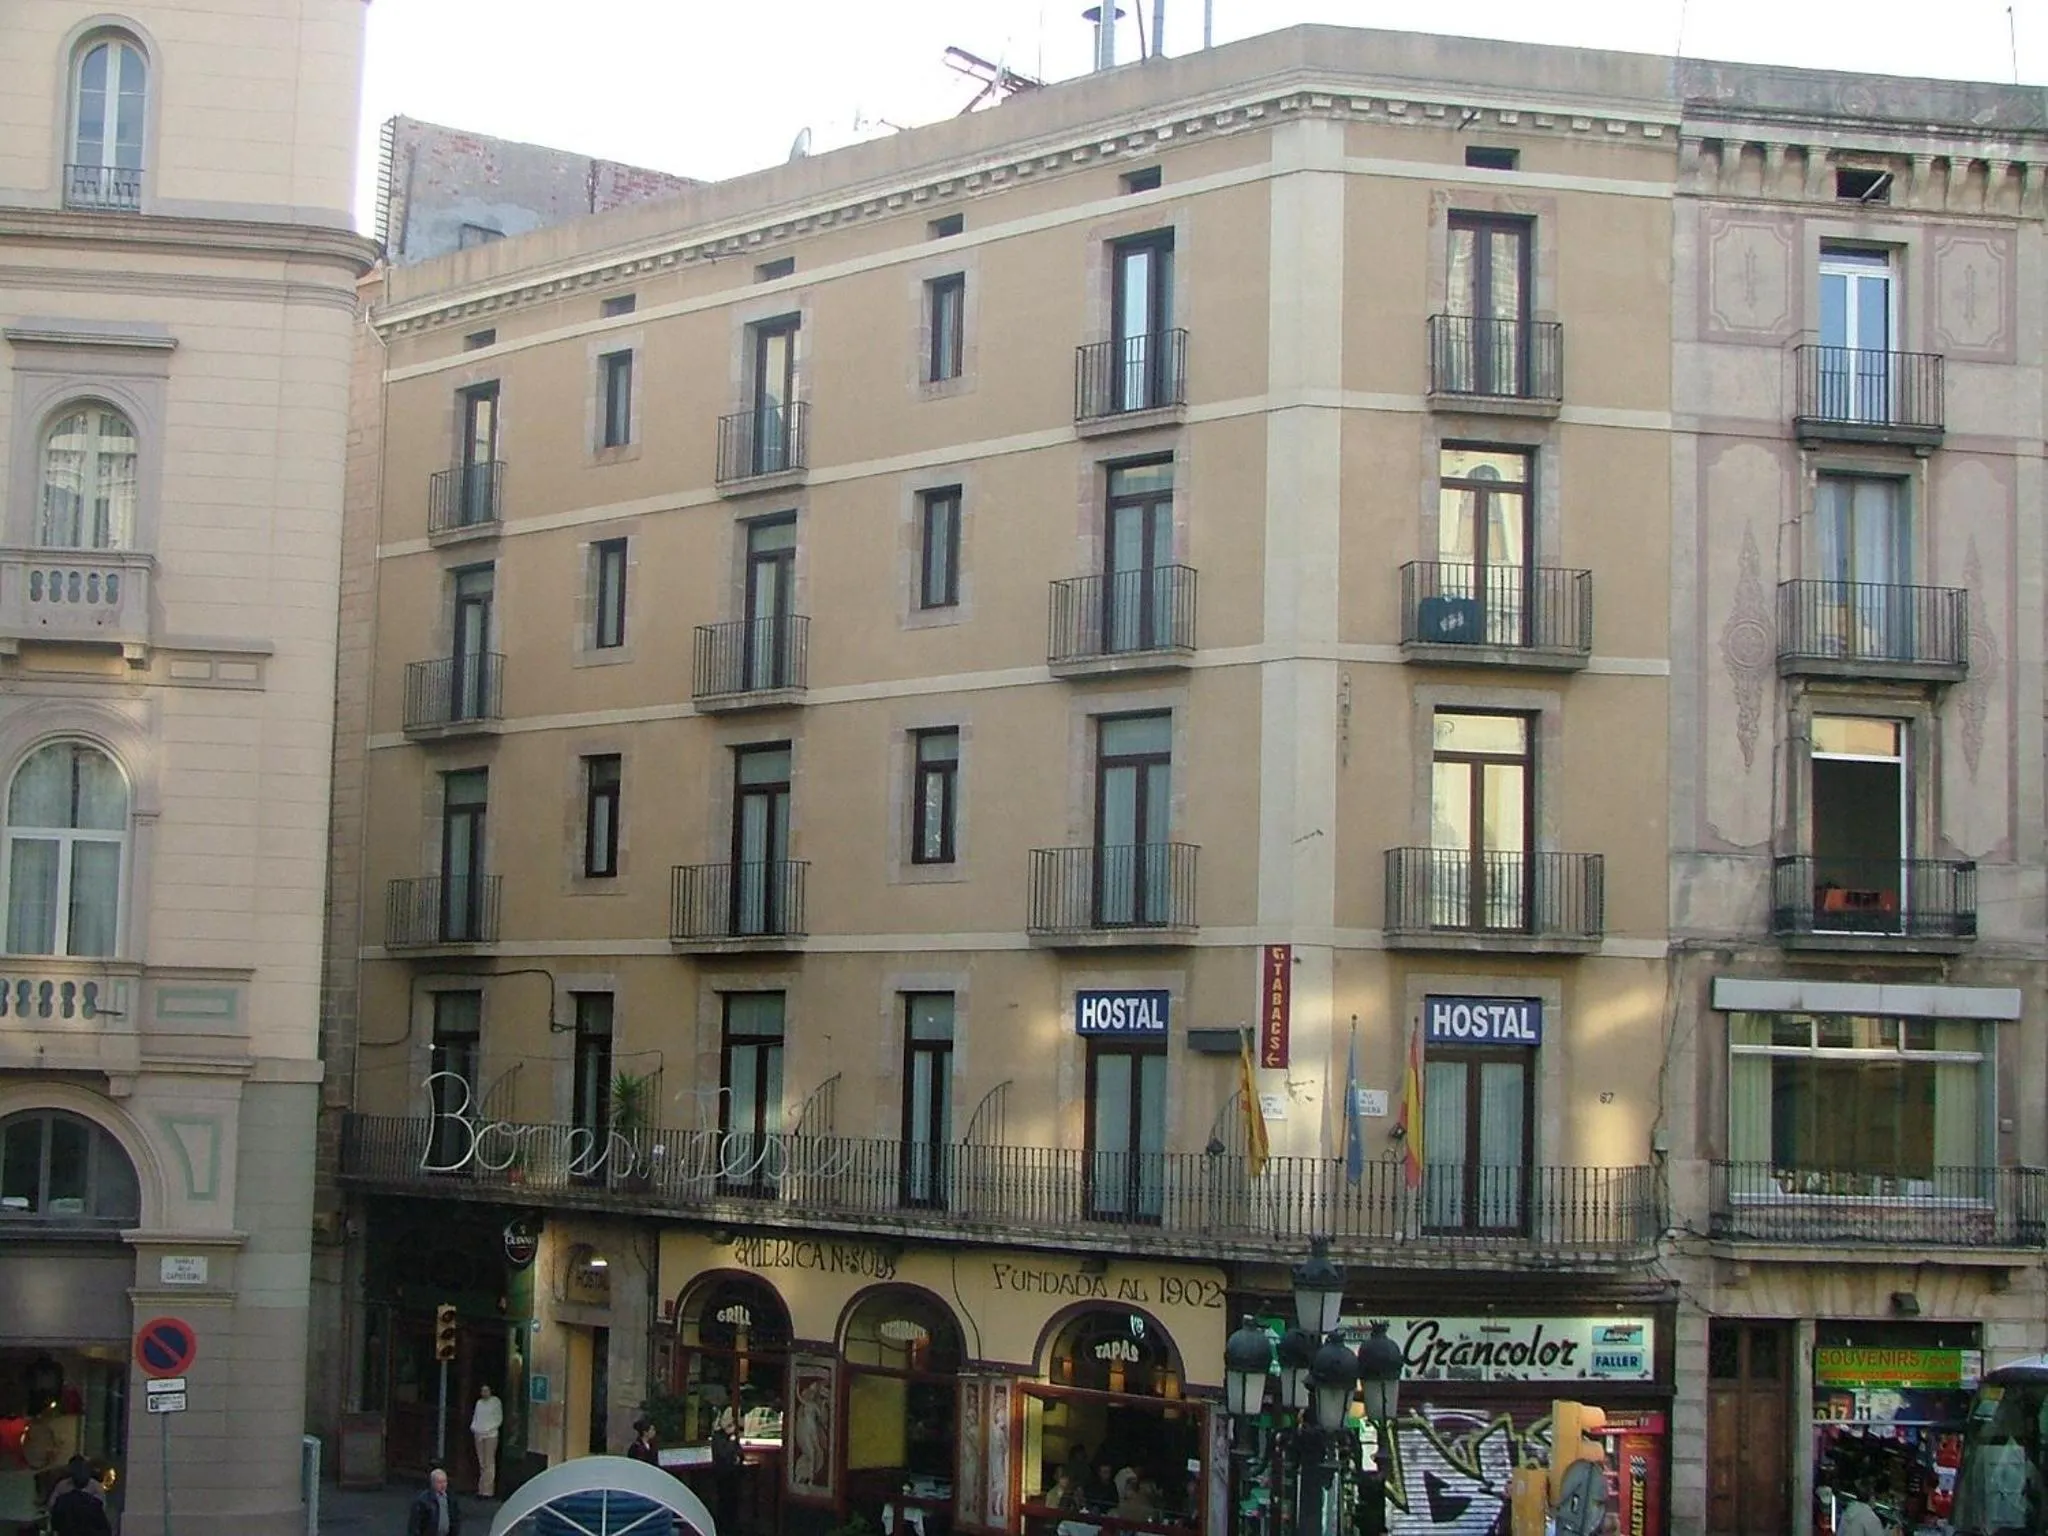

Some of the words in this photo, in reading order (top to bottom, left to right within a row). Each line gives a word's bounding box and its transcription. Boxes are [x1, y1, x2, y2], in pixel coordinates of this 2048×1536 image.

[1081, 996, 1164, 1031] HOSTAL
[1270, 965, 1284, 1050] TABACS
[1432, 1004, 1536, 1040] HOSTAL
[733, 1236, 843, 1273] AMERICAN
[992, 1263, 1107, 1298] FUNDADA
[1118, 1278, 1148, 1302] AL
[1159, 1276, 1222, 1309] 1902
[717, 1305, 752, 1327] GRILL
[1094, 1340, 1139, 1362] TAPAS
[1403, 1319, 1578, 1375] Grancolor
[1595, 1355, 1638, 1367] FALLER
[1819, 1350, 1920, 1367] SOUVENIRS
